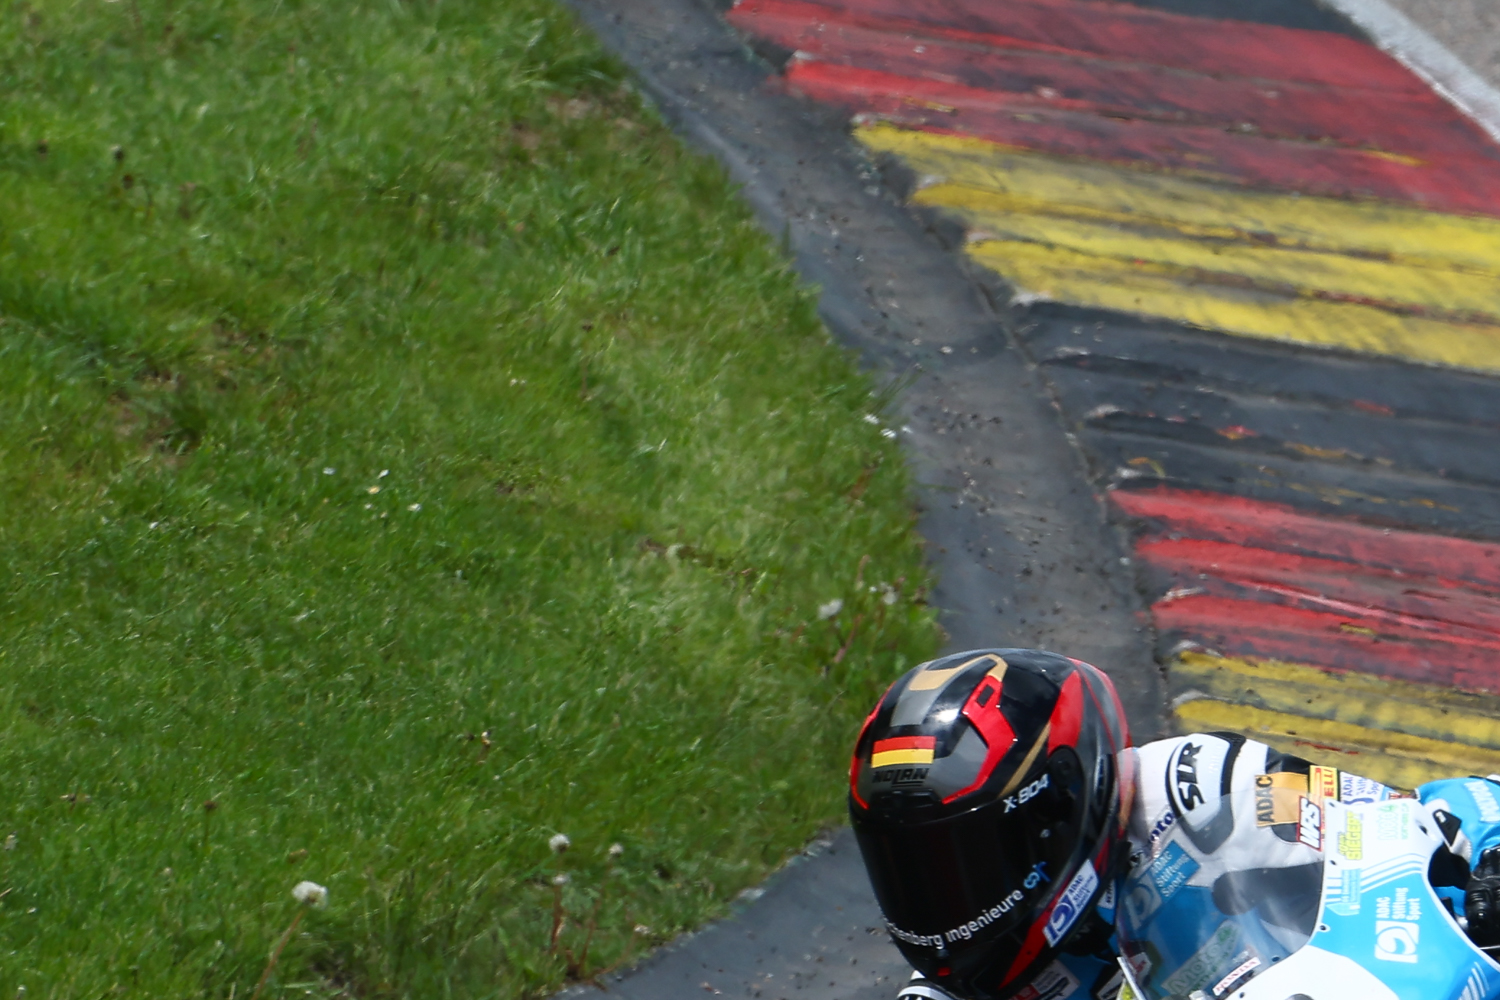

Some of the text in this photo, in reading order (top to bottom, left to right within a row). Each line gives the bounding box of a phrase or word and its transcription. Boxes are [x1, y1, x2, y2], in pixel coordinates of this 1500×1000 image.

[872, 767, 930, 787] NOLAN
[1003, 773, 1050, 814] X-804
[1256, 775, 1275, 824] ADAC
[1346, 810, 1363, 861] SIEGERT
[1155, 853, 1190, 888] Stiftung
[1161, 872, 1187, 898] Sport
[1376, 896, 1391, 919] ADAC
[1392, 887, 1409, 920] Stiftung
[1406, 898, 1423, 921] Sport
